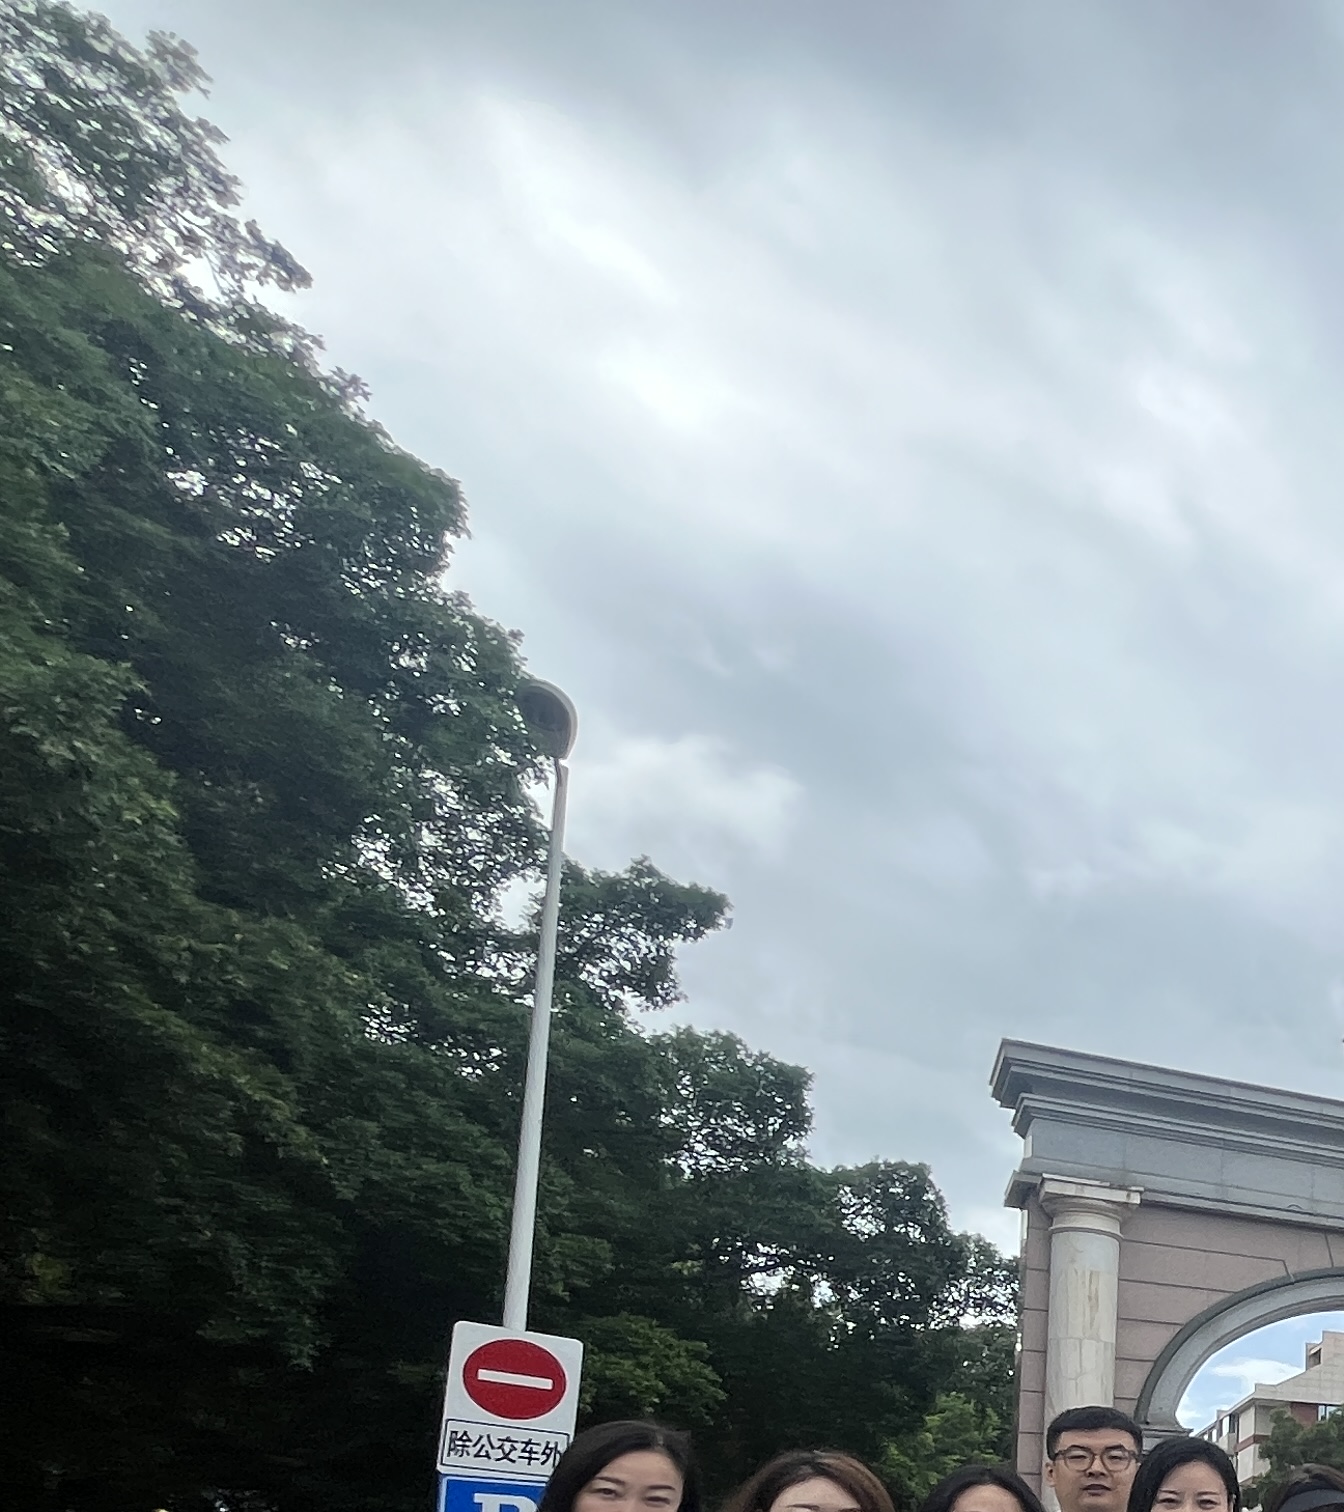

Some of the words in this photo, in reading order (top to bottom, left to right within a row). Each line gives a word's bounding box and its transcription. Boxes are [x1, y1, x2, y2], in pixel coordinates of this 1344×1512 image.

[447, 1430, 562, 1467] 除公交车外
